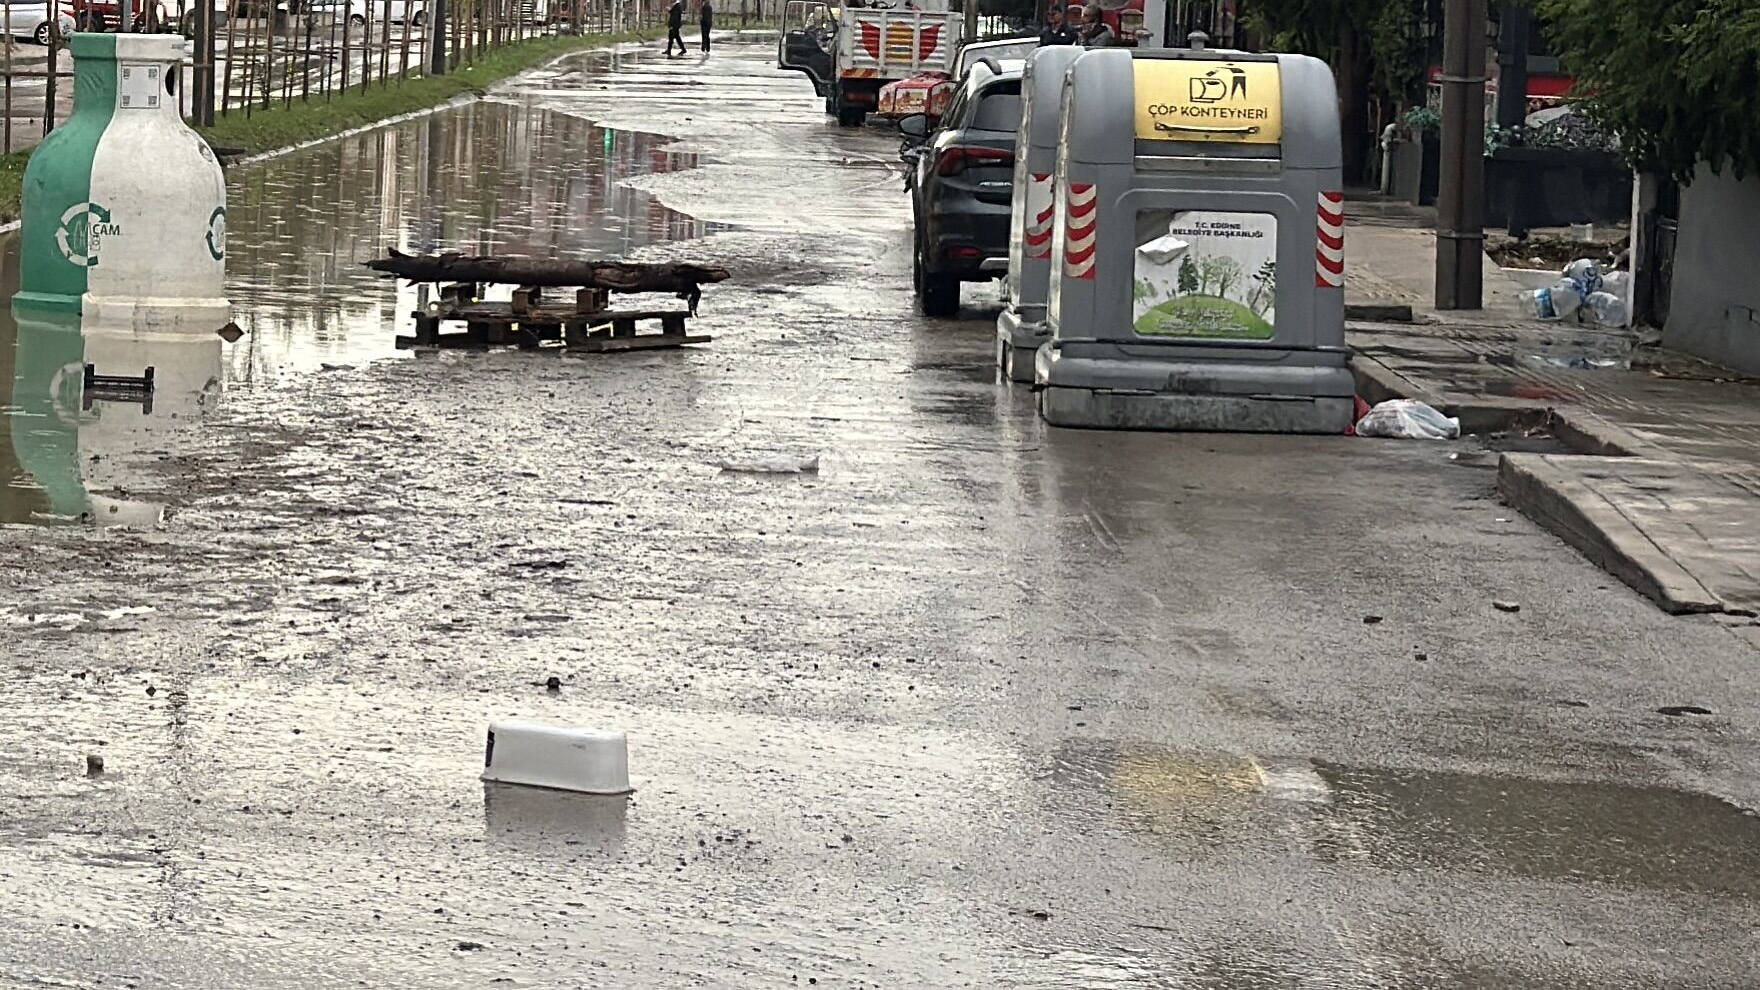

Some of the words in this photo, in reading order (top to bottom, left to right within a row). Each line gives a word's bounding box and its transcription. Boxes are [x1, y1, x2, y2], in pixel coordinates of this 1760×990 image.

[1148, 104, 1178, 118] ÇÖP
[1180, 106, 1268, 119] KONTEYNERİ
[1172, 227, 1212, 236] BELEDİYE
[1213, 229, 1264, 239] BAŞKANLIĞI
